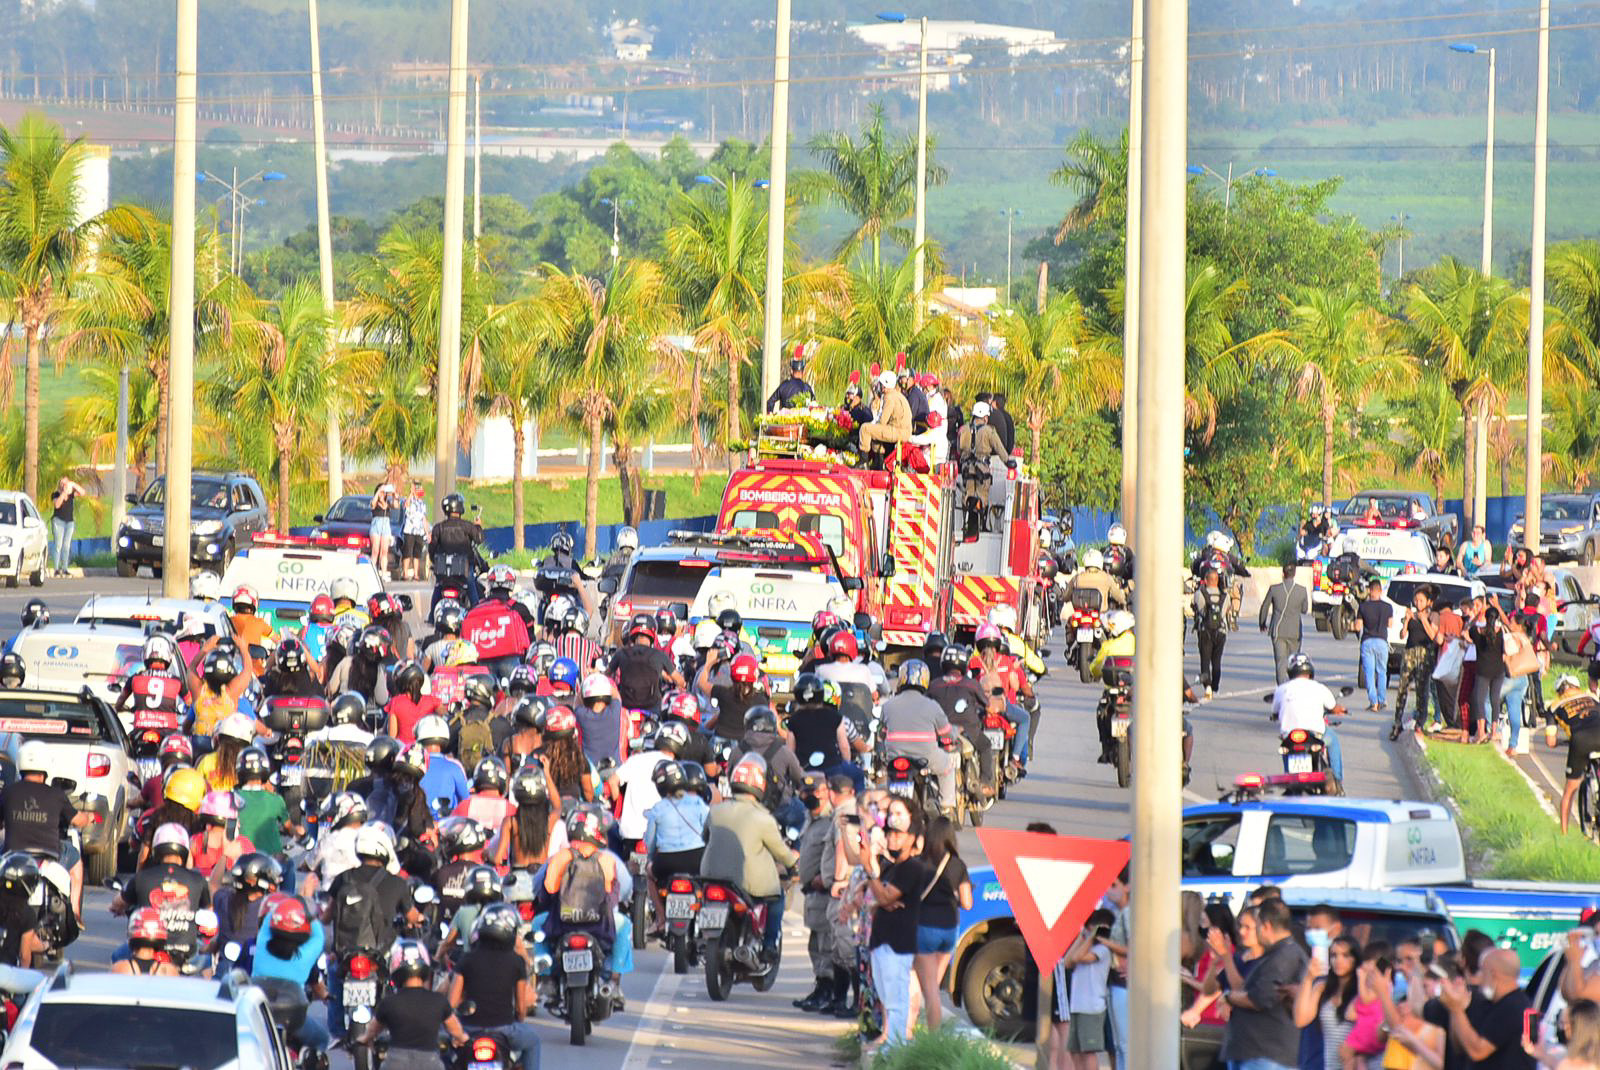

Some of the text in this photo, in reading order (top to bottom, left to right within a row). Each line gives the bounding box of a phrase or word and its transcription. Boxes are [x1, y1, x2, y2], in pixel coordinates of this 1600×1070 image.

[740, 489, 841, 506] BOMBEIRO MILITAR
[278, 561, 304, 574] GO
[750, 583, 774, 595] GO
[145, 677, 165, 709] 9
[12, 810, 48, 824] TAURUS
[1408, 827, 1421, 845] GO
